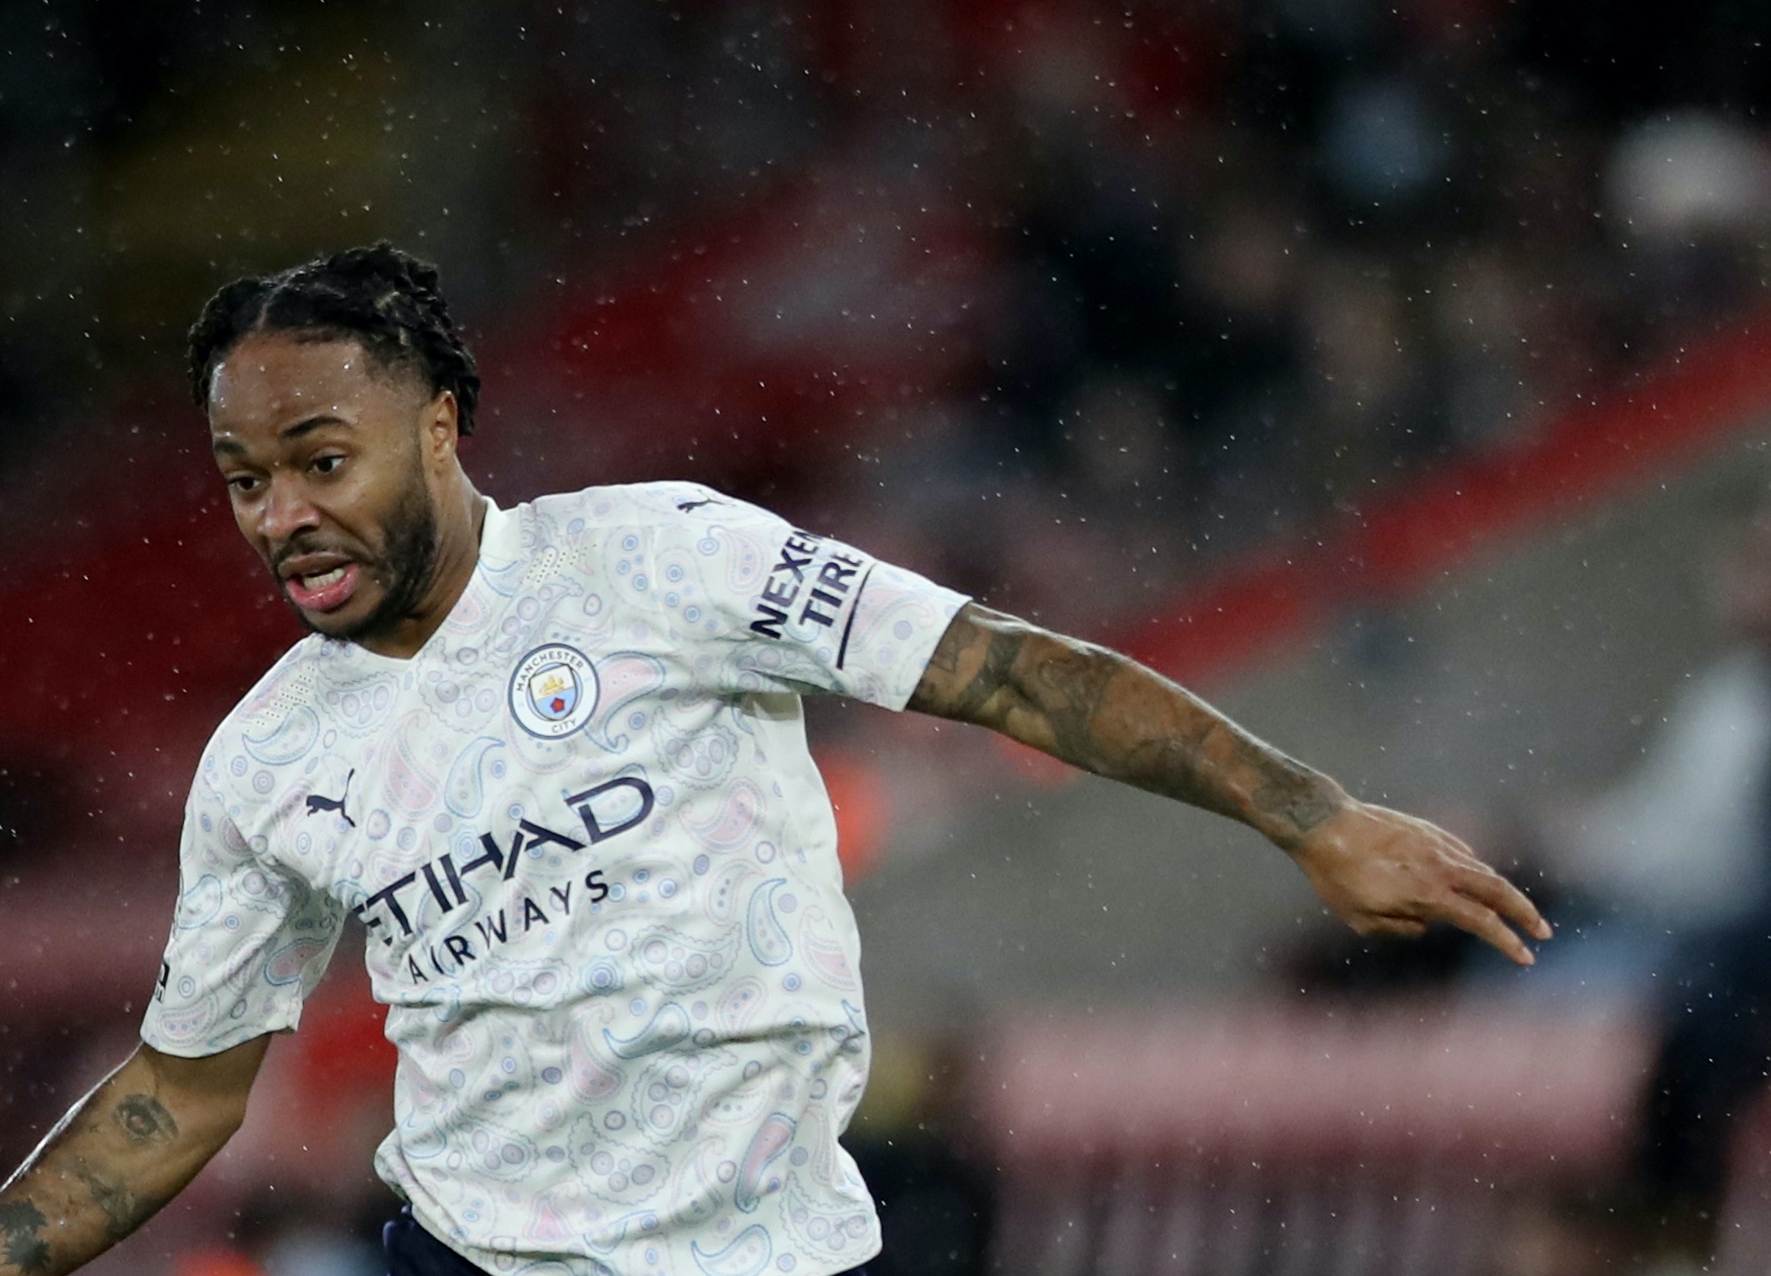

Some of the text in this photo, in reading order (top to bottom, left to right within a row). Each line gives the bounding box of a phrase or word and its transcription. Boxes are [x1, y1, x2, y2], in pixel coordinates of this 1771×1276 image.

[798, 551, 863, 628] TIRE
[516, 650, 585, 692] MANCHESTER
[551, 718, 577, 733] CITY
[353, 777, 654, 946] ETIHAD
[406, 869, 610, 985] AIRWAYS
